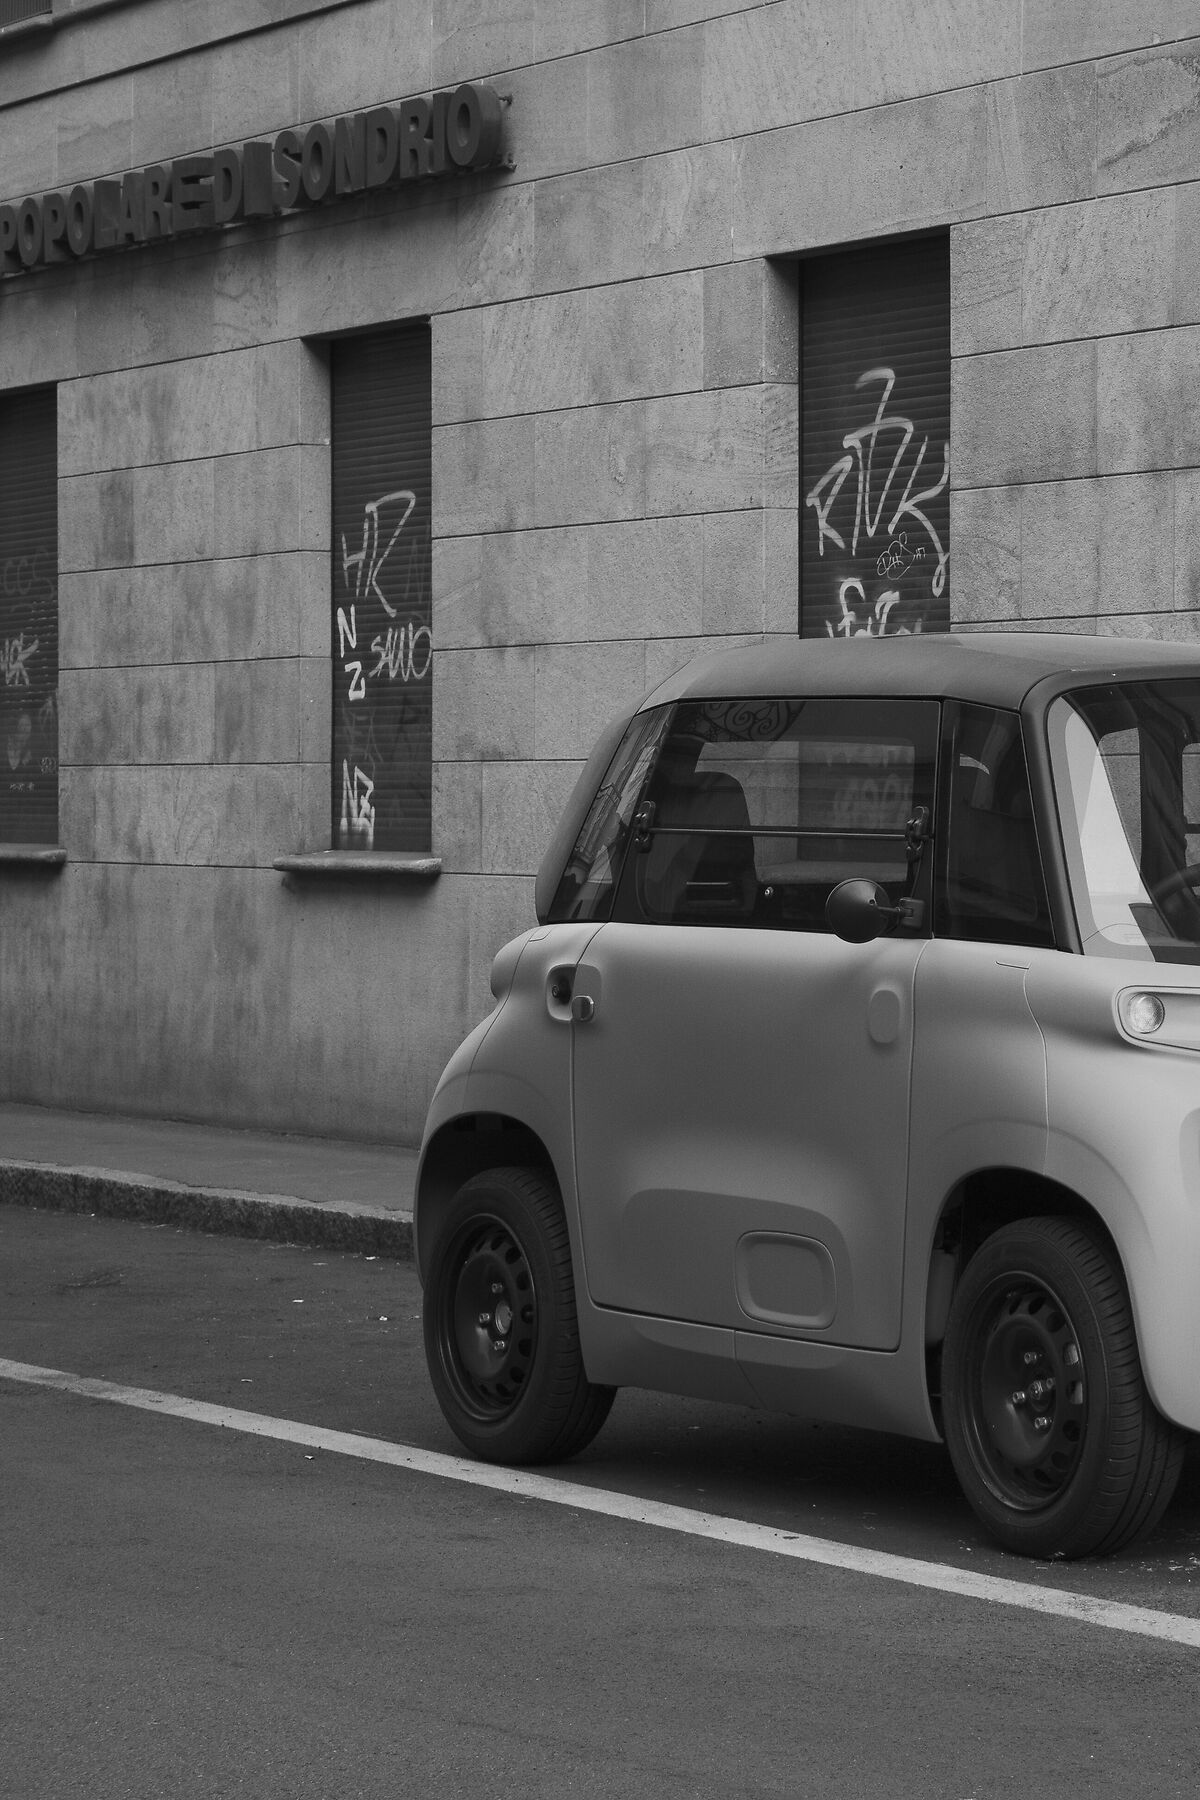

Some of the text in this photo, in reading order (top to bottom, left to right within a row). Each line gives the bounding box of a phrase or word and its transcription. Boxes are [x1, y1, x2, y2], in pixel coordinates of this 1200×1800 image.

[0, 84, 500, 273] POPOLARE DI SONDRIO
